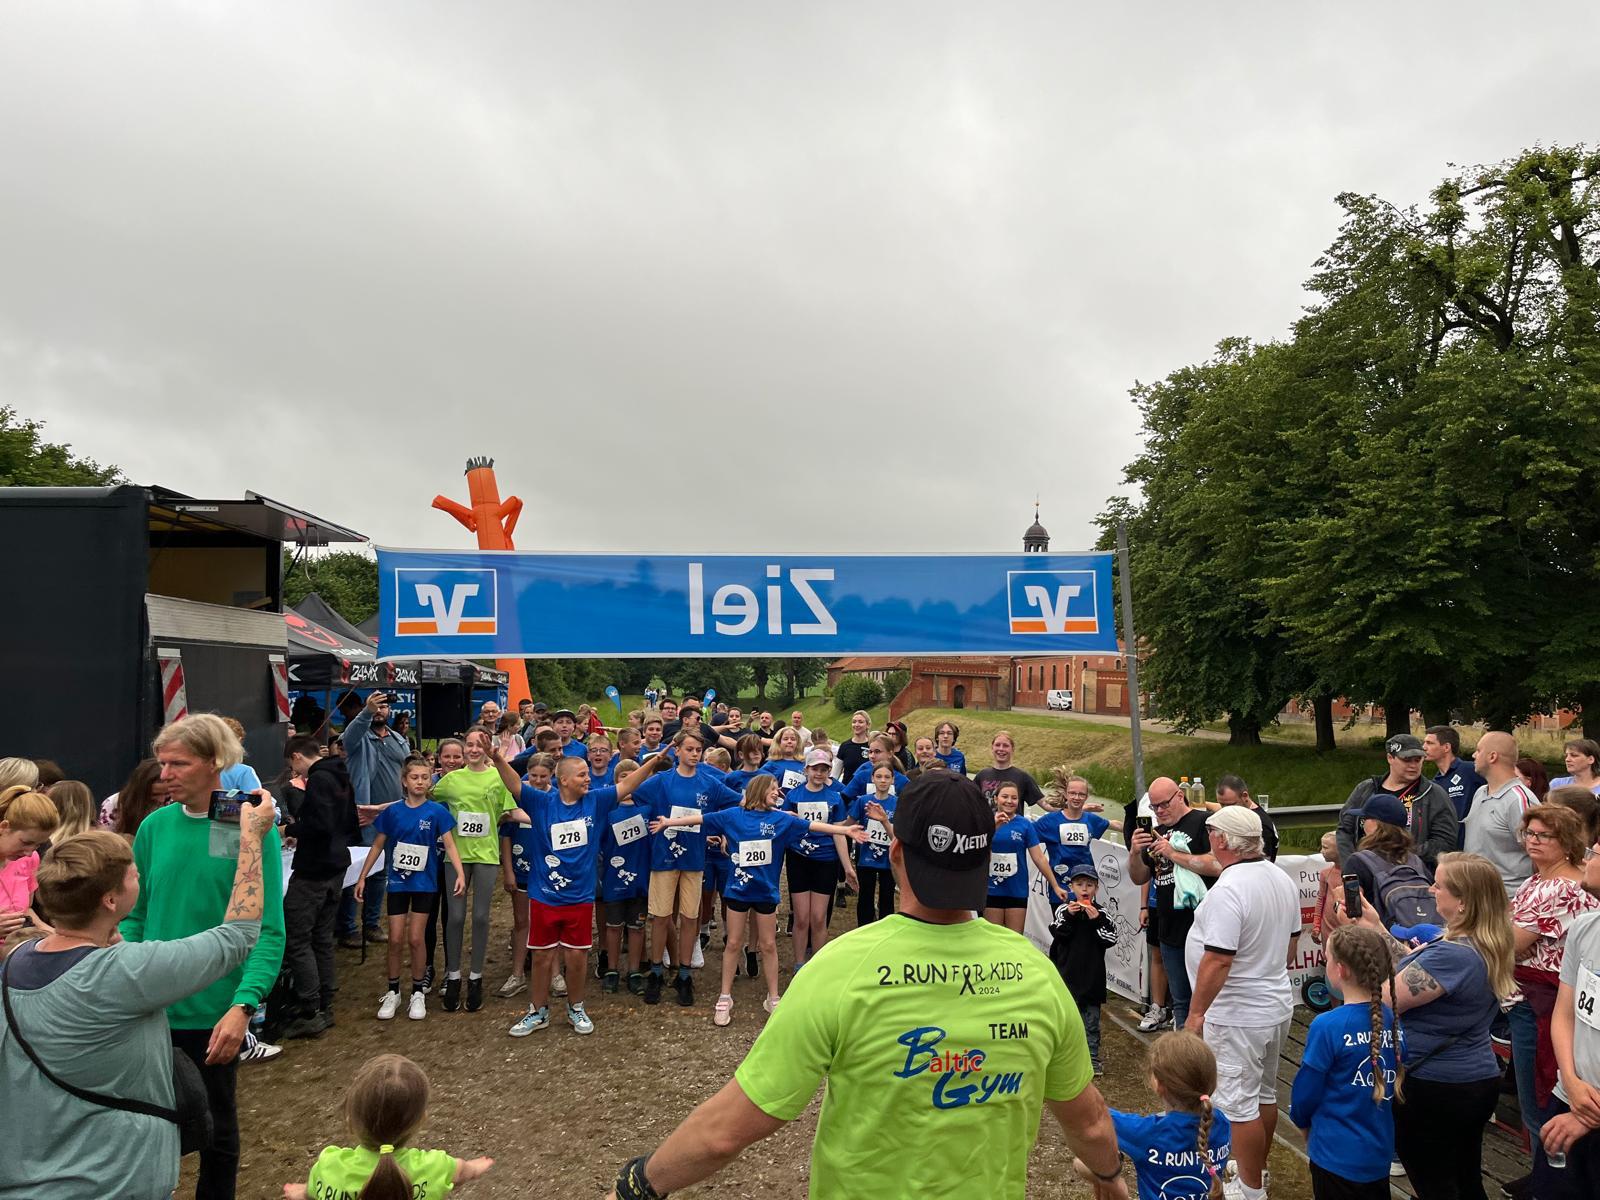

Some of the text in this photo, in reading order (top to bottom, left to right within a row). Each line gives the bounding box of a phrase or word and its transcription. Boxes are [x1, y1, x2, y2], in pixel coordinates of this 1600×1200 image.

[350, 664, 379, 682] 24MX
[395, 667, 418, 684] 24MX
[1448, 785, 1464, 793] ERGO
[803, 811, 822, 821] 214
[462, 822, 483, 833] 288
[621, 825, 641, 840] 279
[559, 831, 581, 845] 278
[871, 830, 888, 841] 213
[1066, 832, 1085, 842] 285
[952, 833, 988, 854] XLETIX
[399, 854, 421, 866] 230
[746, 850, 766, 862] 280
[993, 863, 1011, 873] 284
[877, 965, 899, 986] 2.
[903, 963, 947, 984] RUN
[990, 962, 1023, 983] KIDS
[978, 987, 1001, 995] 2024
[1578, 990, 1595, 1016] 84
[988, 1023, 1028, 1040] TEAM
[1343, 1033, 1357, 1046] 2.
[1357, 1031, 1372, 1044] RU
[893, 1026, 985, 1079] Baltic
[932, 1049, 1024, 1110] Gym
[1148, 1148, 1162, 1166] 2.
[1165, 1151, 1194, 1167] RUN
[1195, 1149, 1215, 1167] FR
